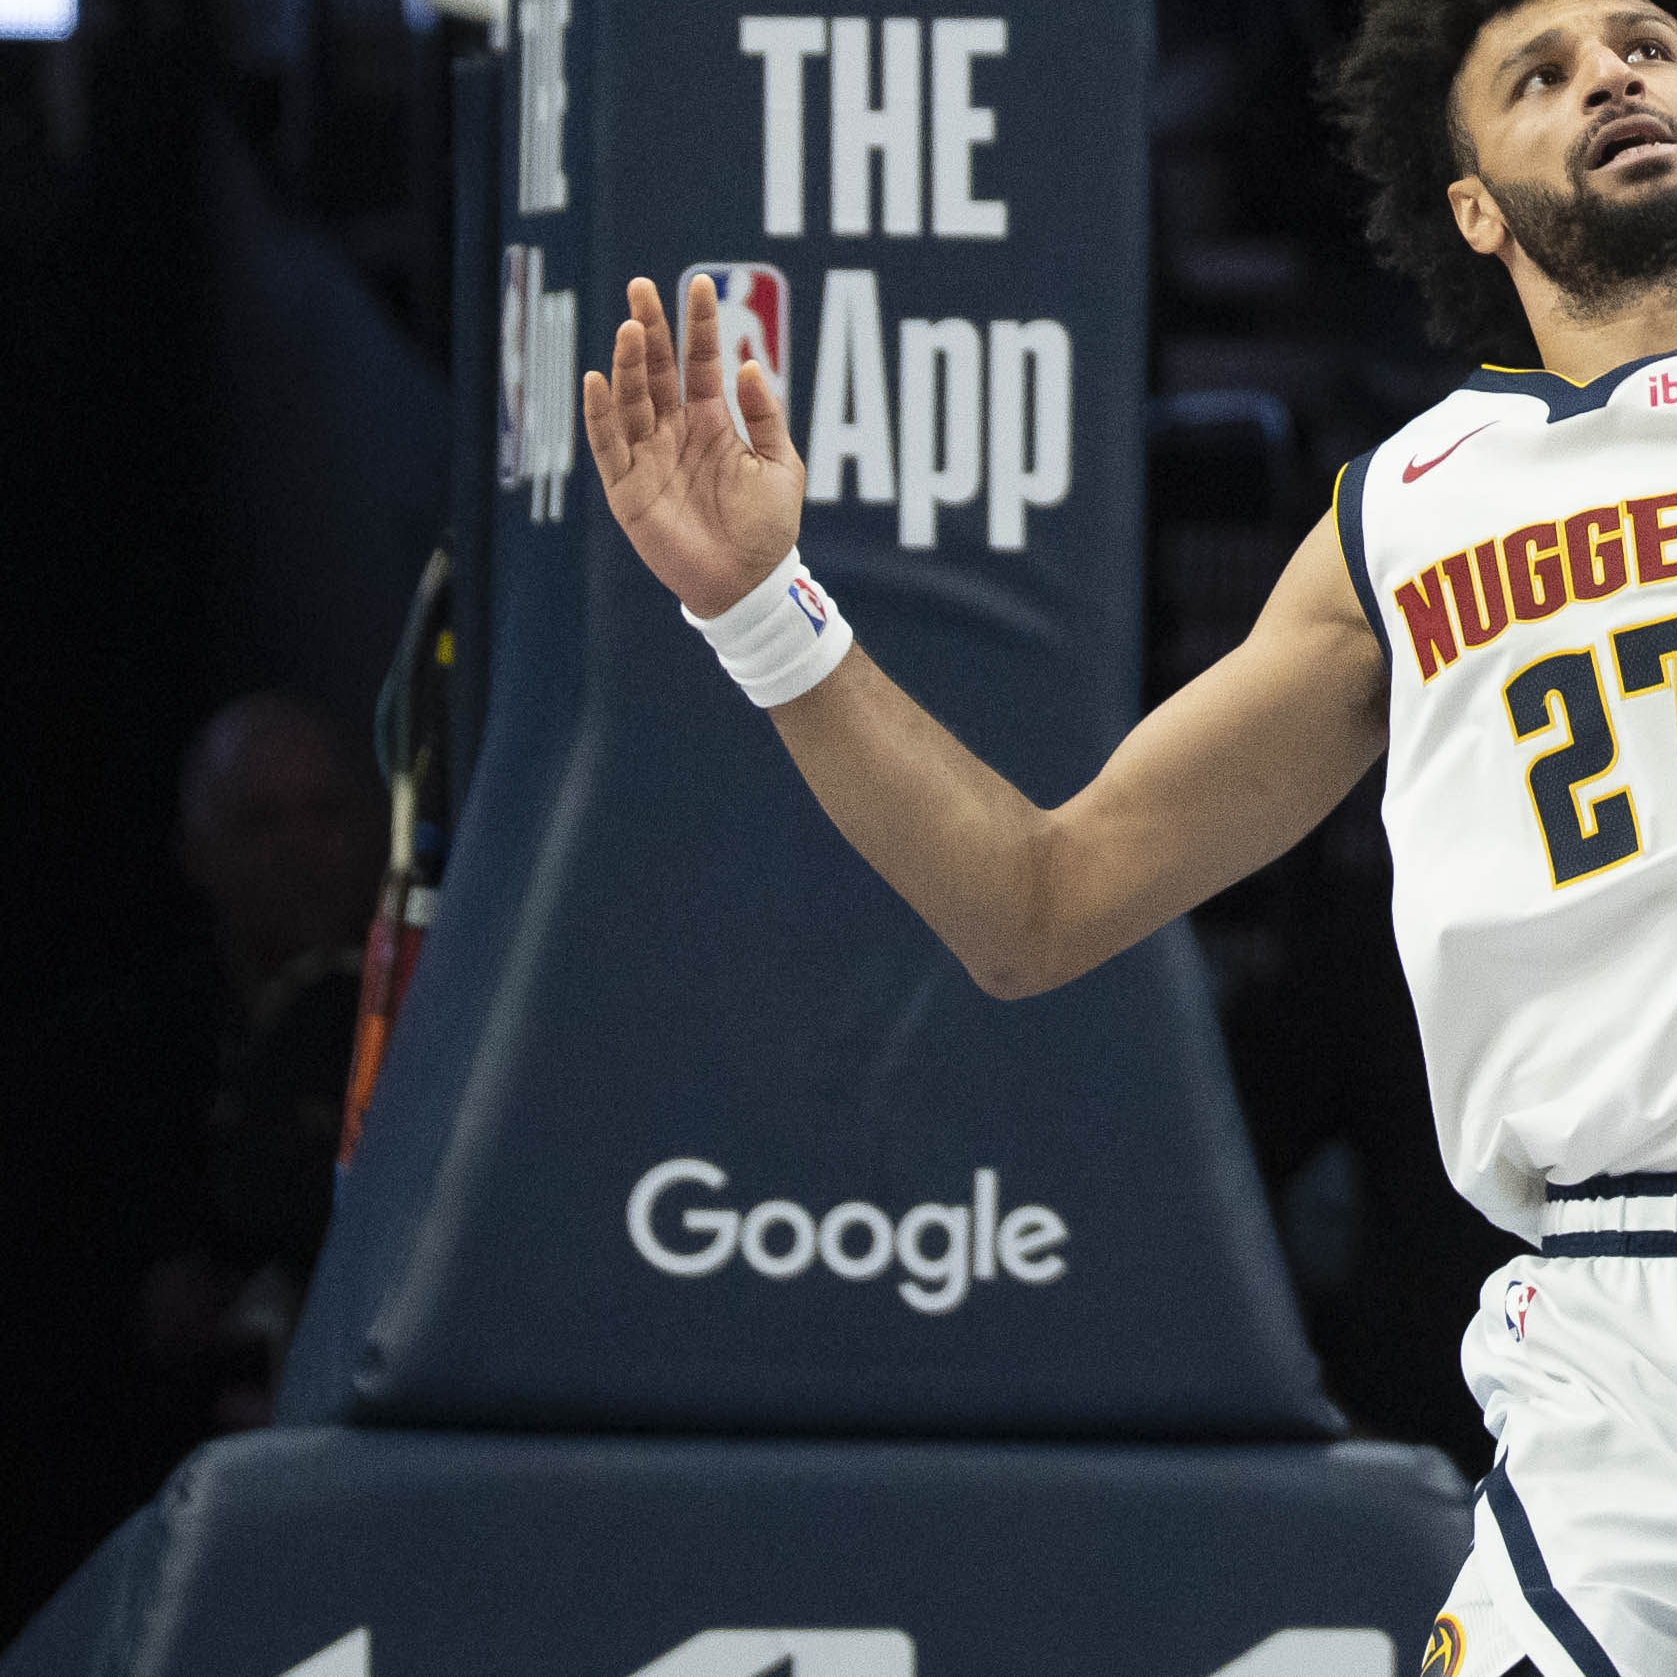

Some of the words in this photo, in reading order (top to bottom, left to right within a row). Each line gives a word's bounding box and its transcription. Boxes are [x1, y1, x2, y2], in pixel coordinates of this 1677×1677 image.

[740, 16, 1008, 238] THE
[806, 268, 1074, 550] App
[626, 1158, 1069, 1314] Google
